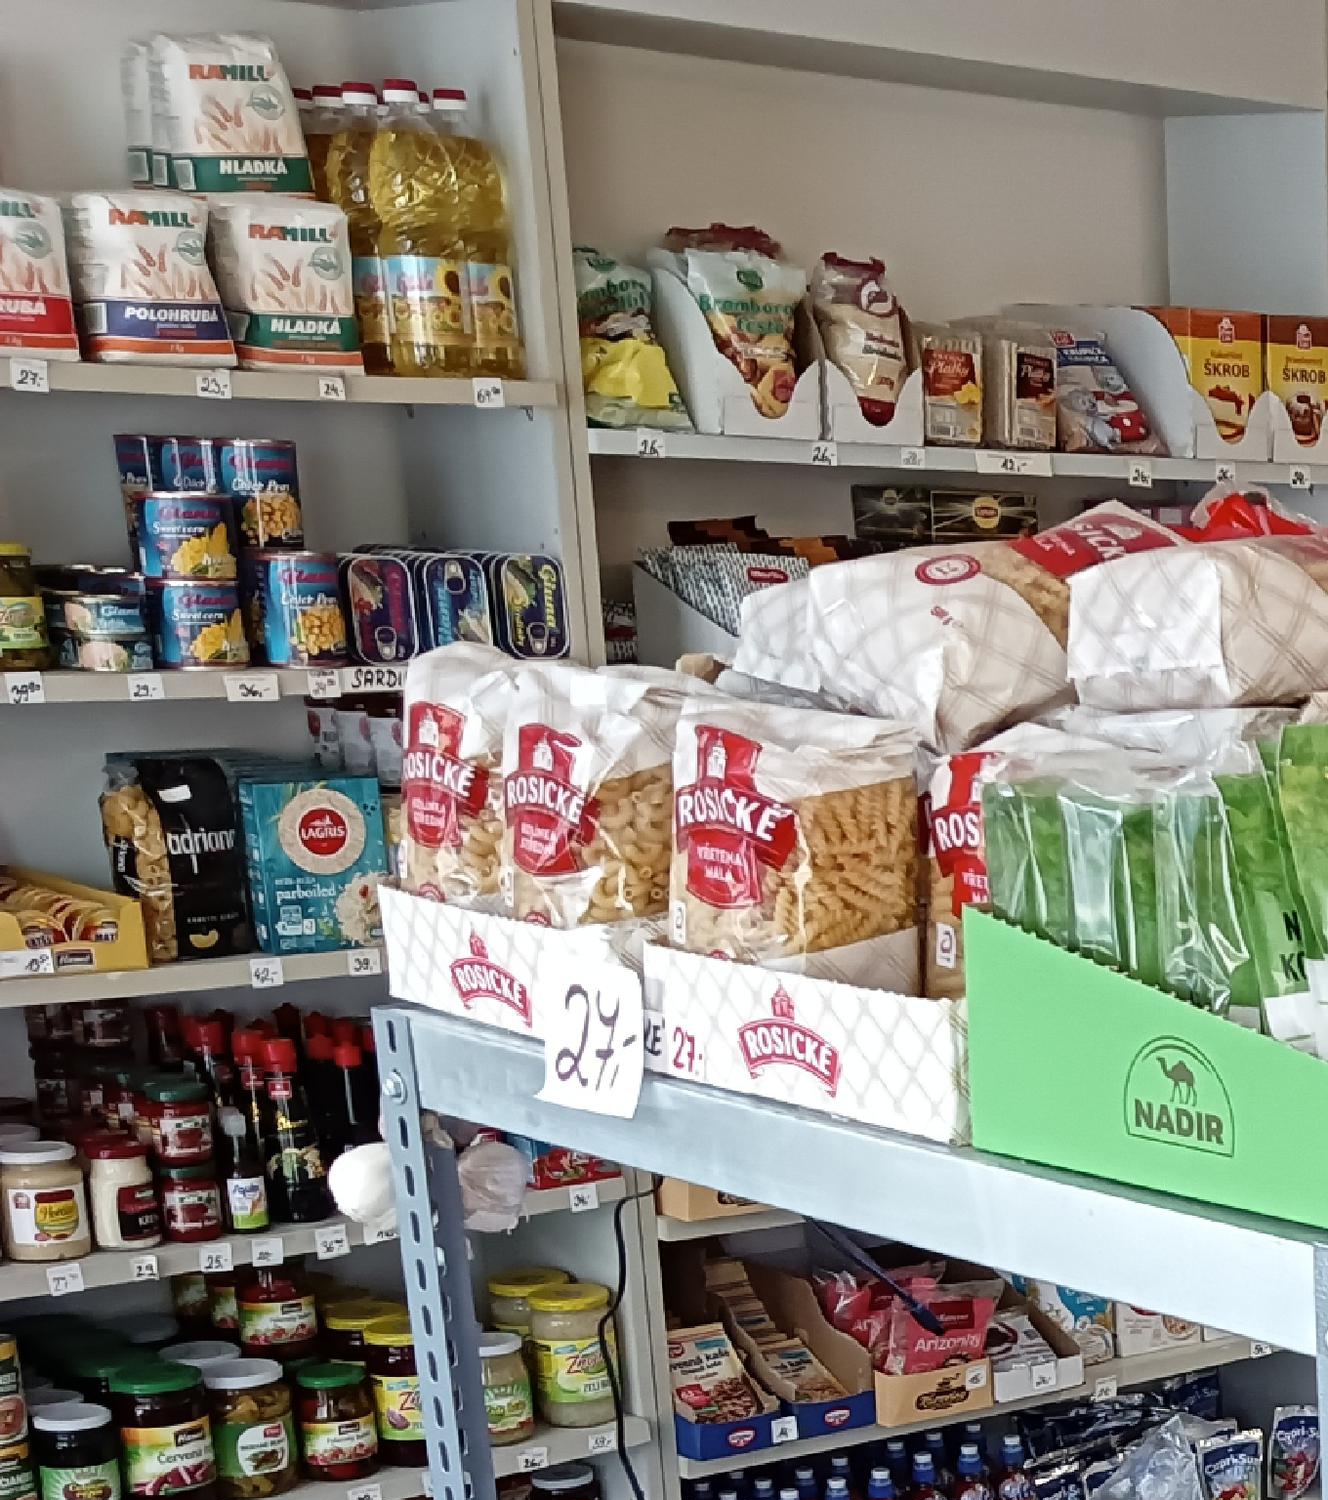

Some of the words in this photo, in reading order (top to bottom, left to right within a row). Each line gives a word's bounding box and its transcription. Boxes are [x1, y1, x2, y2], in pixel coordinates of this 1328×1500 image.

[108, 208, 194, 228] RAMILL
[249, 223, 331, 243] RAMILL
[124, 306, 219, 324] POLOHRUBÁ
[270, 317, 342, 336] HLADKÁ
[1203, 357, 1251, 379] ŠKROB
[351, 667, 402, 689] SARDI
[506, 778, 586, 825] ROSICKÉ
[678, 792, 780, 842] ROSICKÉ
[300, 824, 347, 840] LAGRIS
[455, 964, 529, 1010] ROSICKÉ
[742, 1025, 836, 1081] ROSICKÉ
[1134, 1097, 1224, 1145] NADIR
